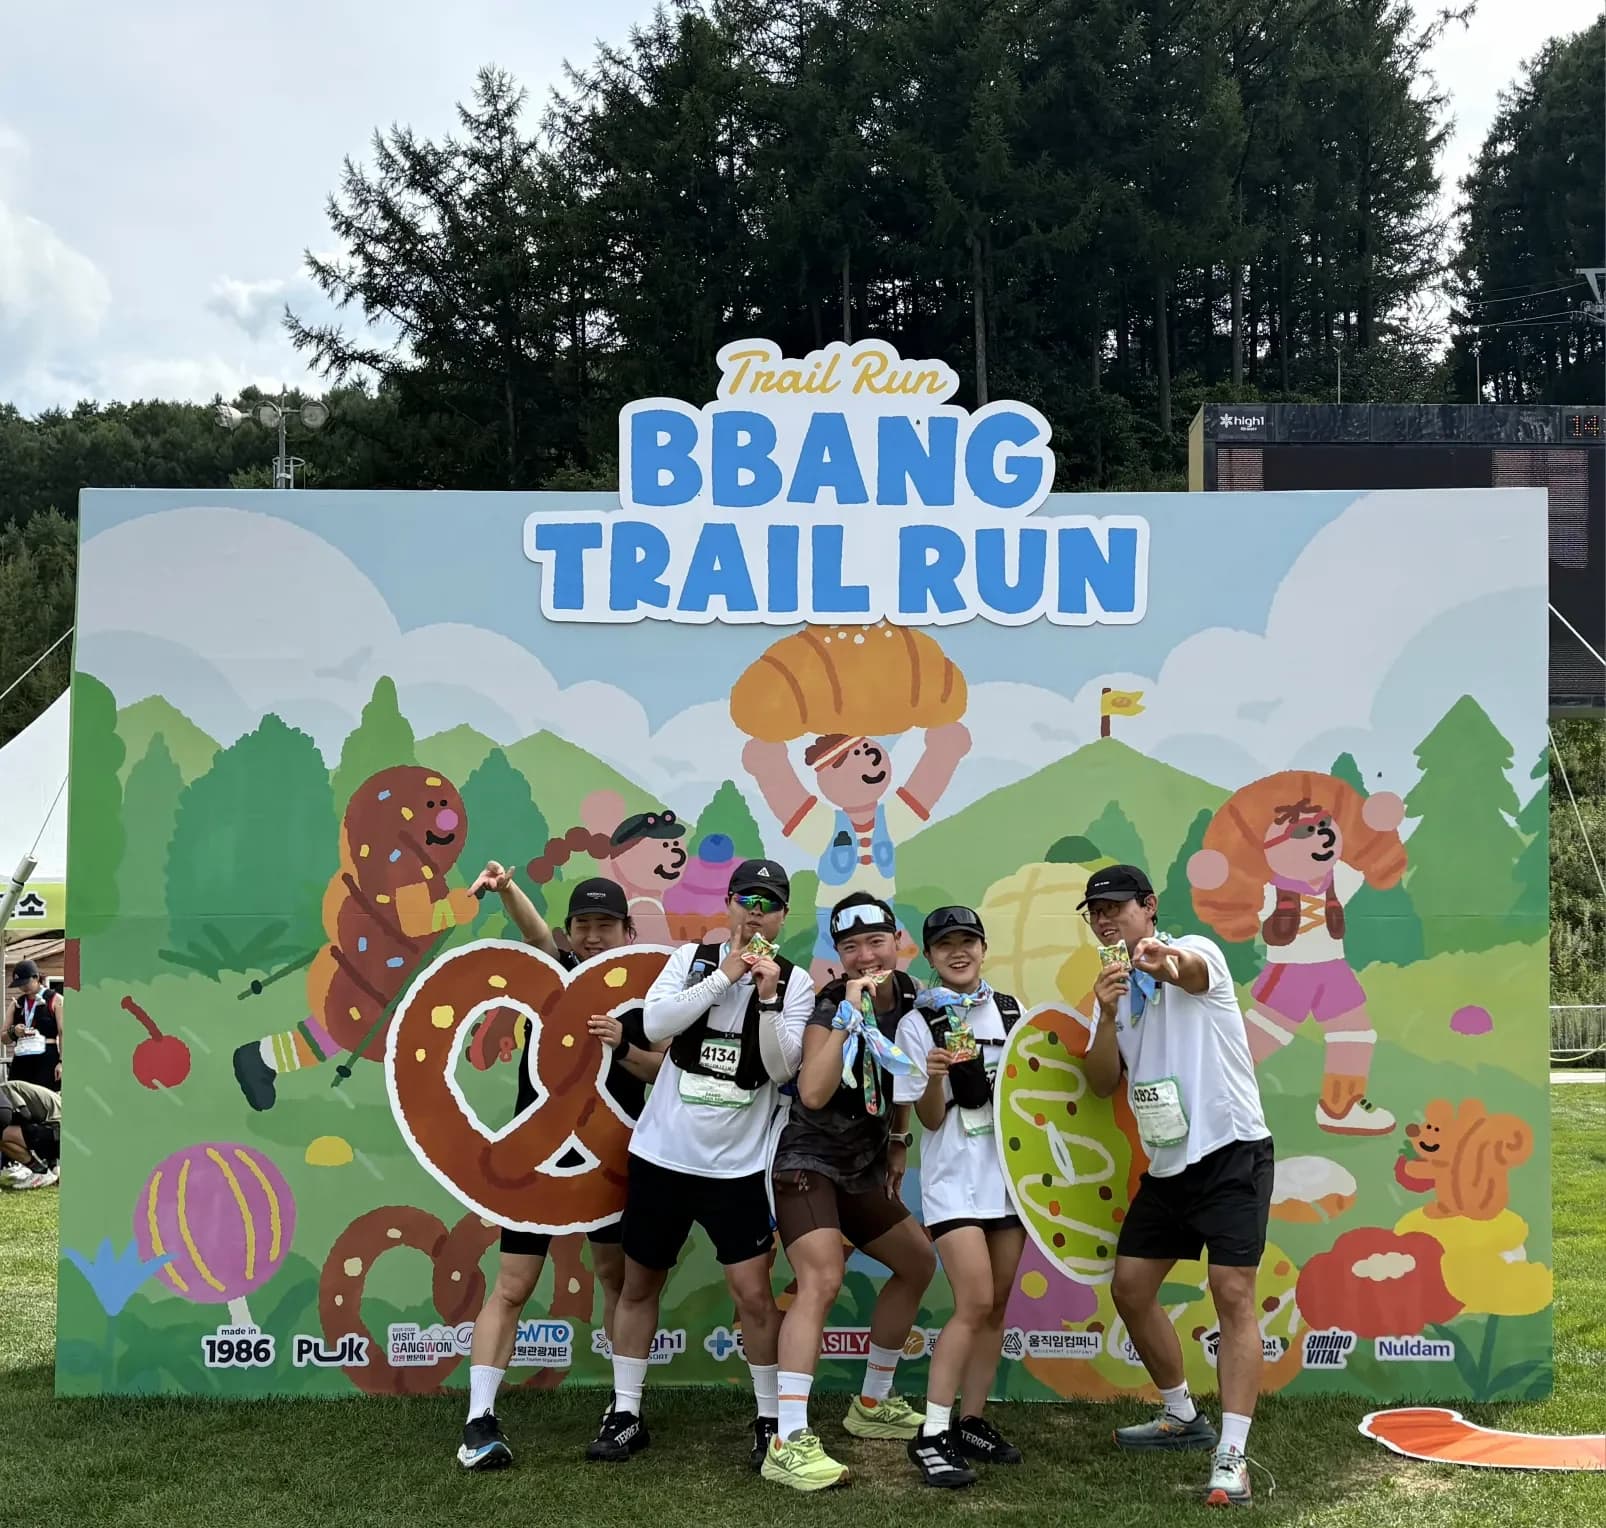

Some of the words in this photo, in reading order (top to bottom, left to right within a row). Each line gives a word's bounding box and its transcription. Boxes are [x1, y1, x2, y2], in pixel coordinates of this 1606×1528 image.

[728, 350, 841, 395] Trail
[851, 350, 948, 395] Run
[631, 410, 1044, 508] BBANG
[535, 521, 870, 613] TRAIL
[899, 524, 1137, 614] RUN
[702, 1046, 736, 1064] 4134
[1134, 1087, 1159, 1102] 4823
[221, 1327, 246, 1335] made
[248, 1326, 257, 1335] in
[392, 1332, 416, 1341] VISIT
[392, 1342, 452, 1353] GANGWON
[650, 1333, 682, 1353] gh1
[1028, 1335, 1098, 1349] 움직임컴퍼니
[1306, 1331, 1352, 1349] amino
[1379, 1340, 1450, 1356] Nuldam
[206, 1339, 271, 1363] 1986
[513, 1346, 567, 1357] 원관광재단
[1306, 1350, 1343, 1364] VITAL
[961, 1429, 996, 1453] TERREX
